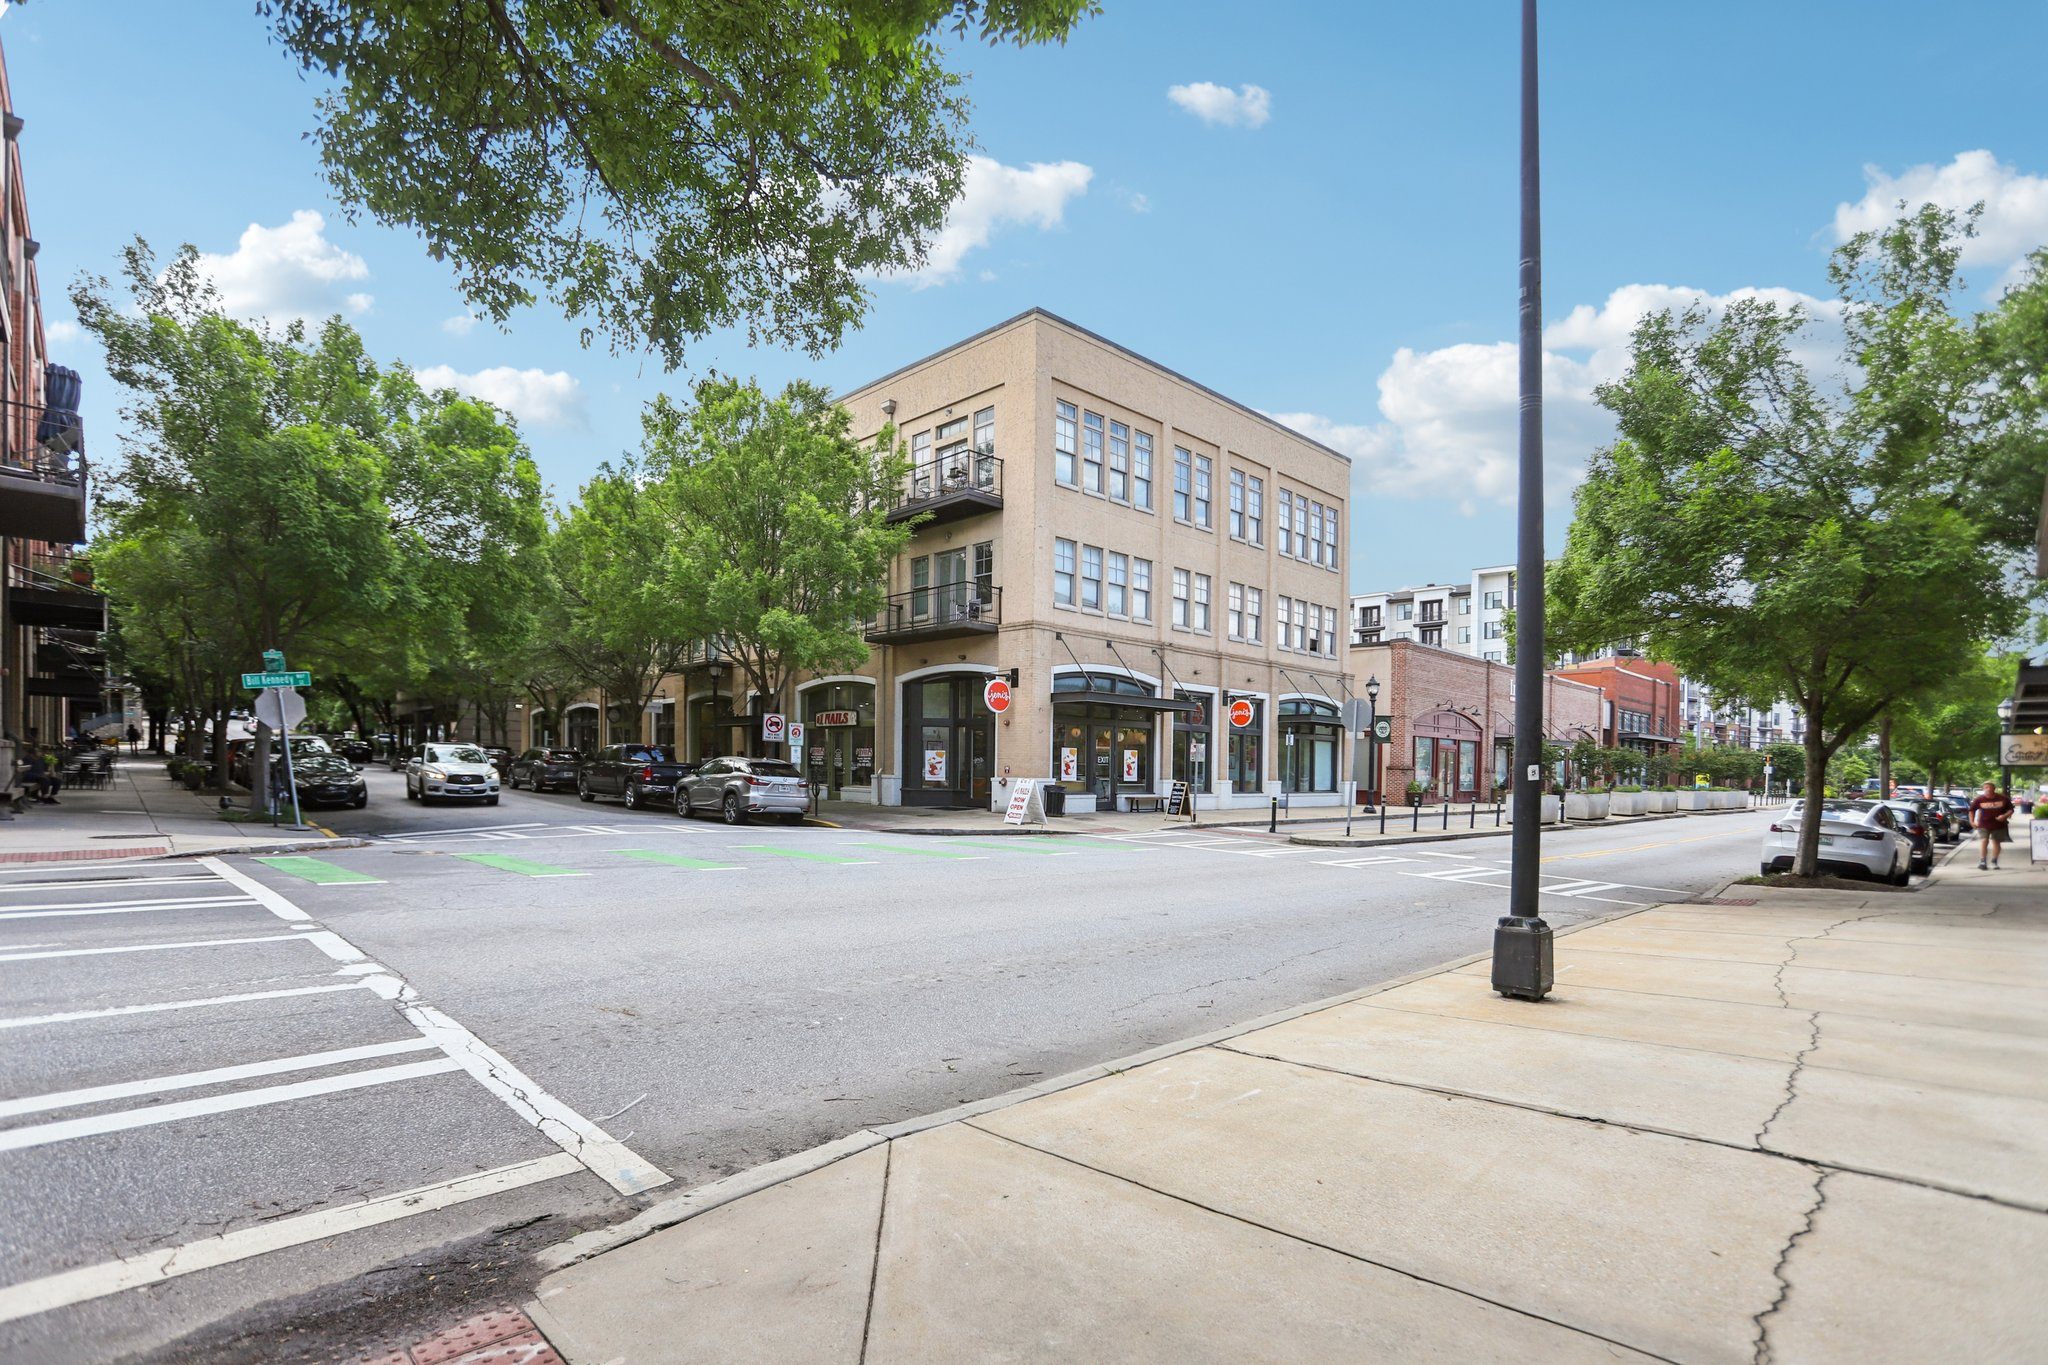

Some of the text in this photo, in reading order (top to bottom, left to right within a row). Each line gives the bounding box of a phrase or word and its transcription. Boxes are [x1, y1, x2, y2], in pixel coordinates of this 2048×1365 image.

[245, 674, 294, 686] Bill Kennedy
[825, 712, 849, 724] NAILS
